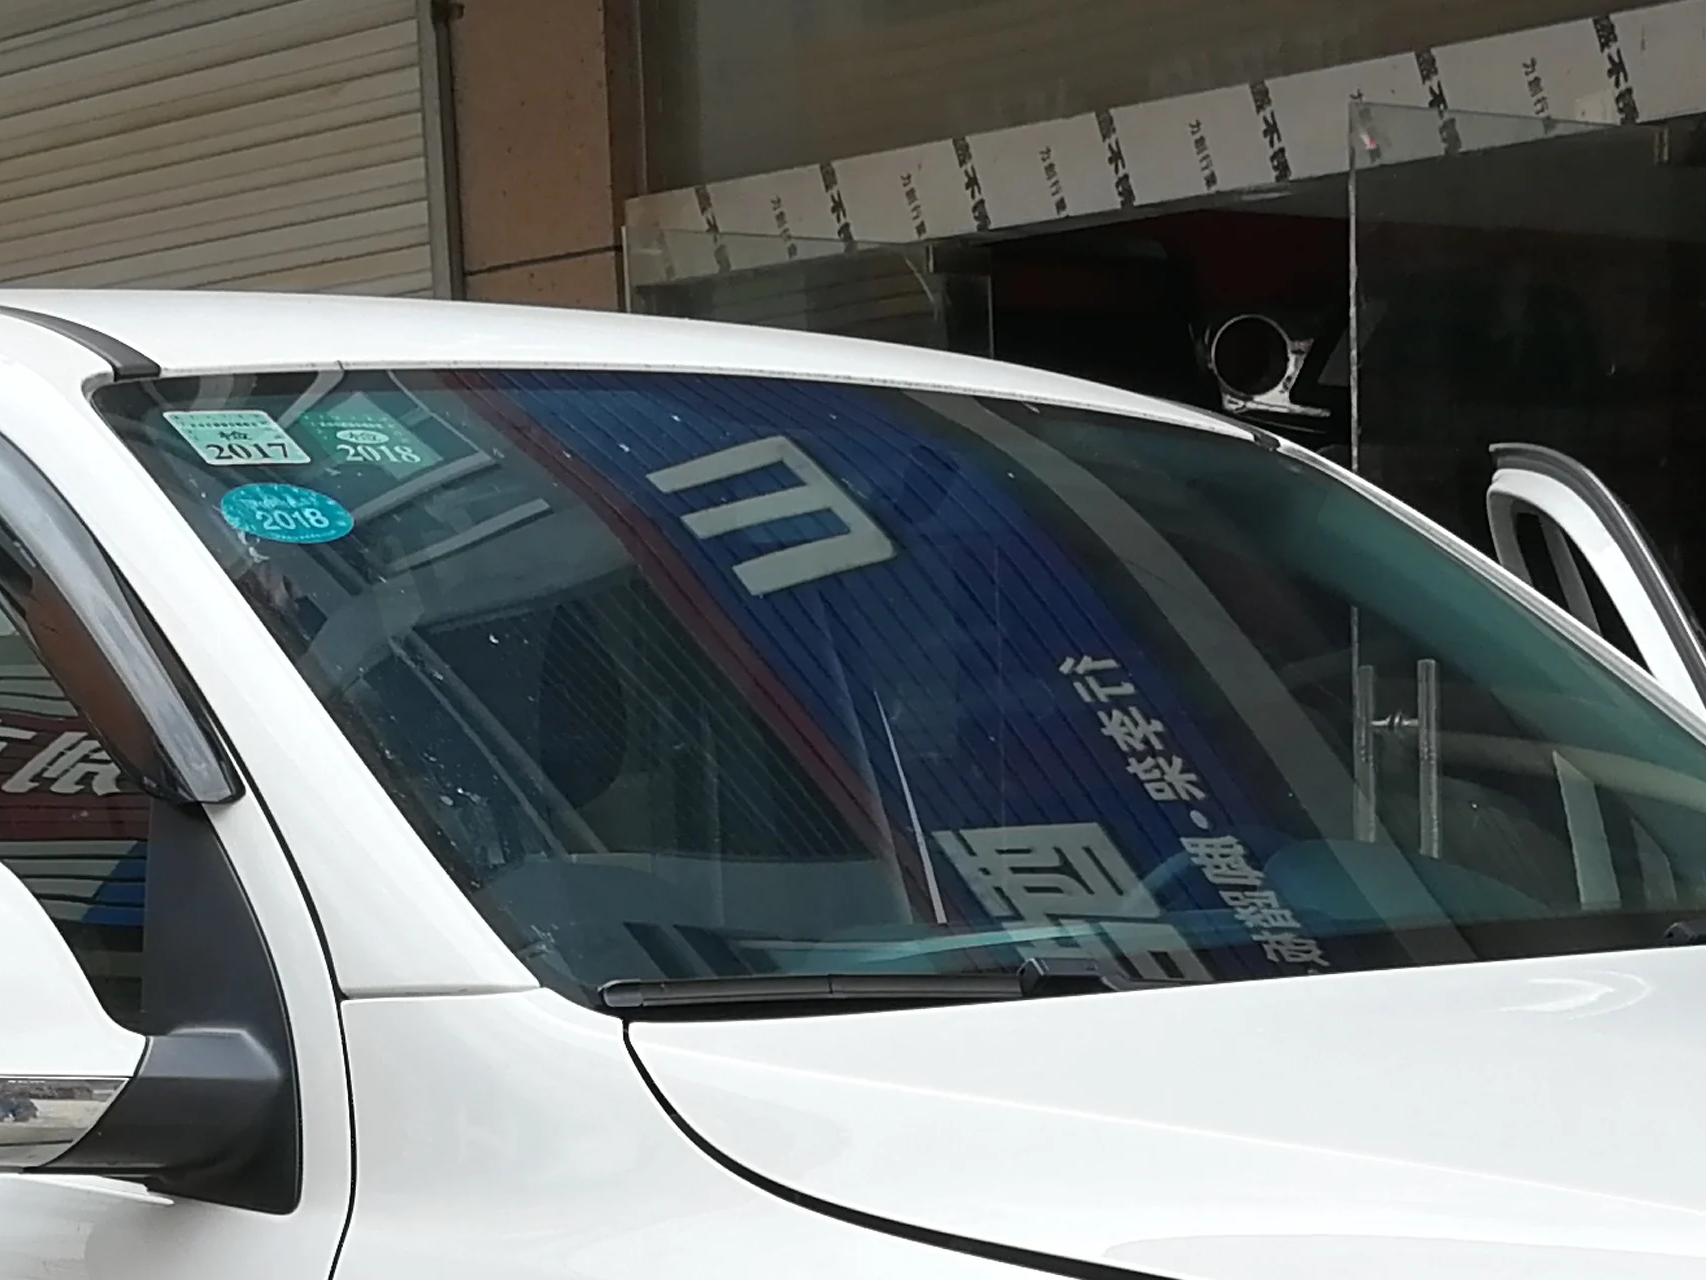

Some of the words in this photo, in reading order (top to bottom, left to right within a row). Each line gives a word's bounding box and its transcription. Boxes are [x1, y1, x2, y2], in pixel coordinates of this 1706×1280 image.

[206, 442, 289, 460] 2017
[336, 443, 422, 464] 2018
[254, 508, 330, 531] 2018
